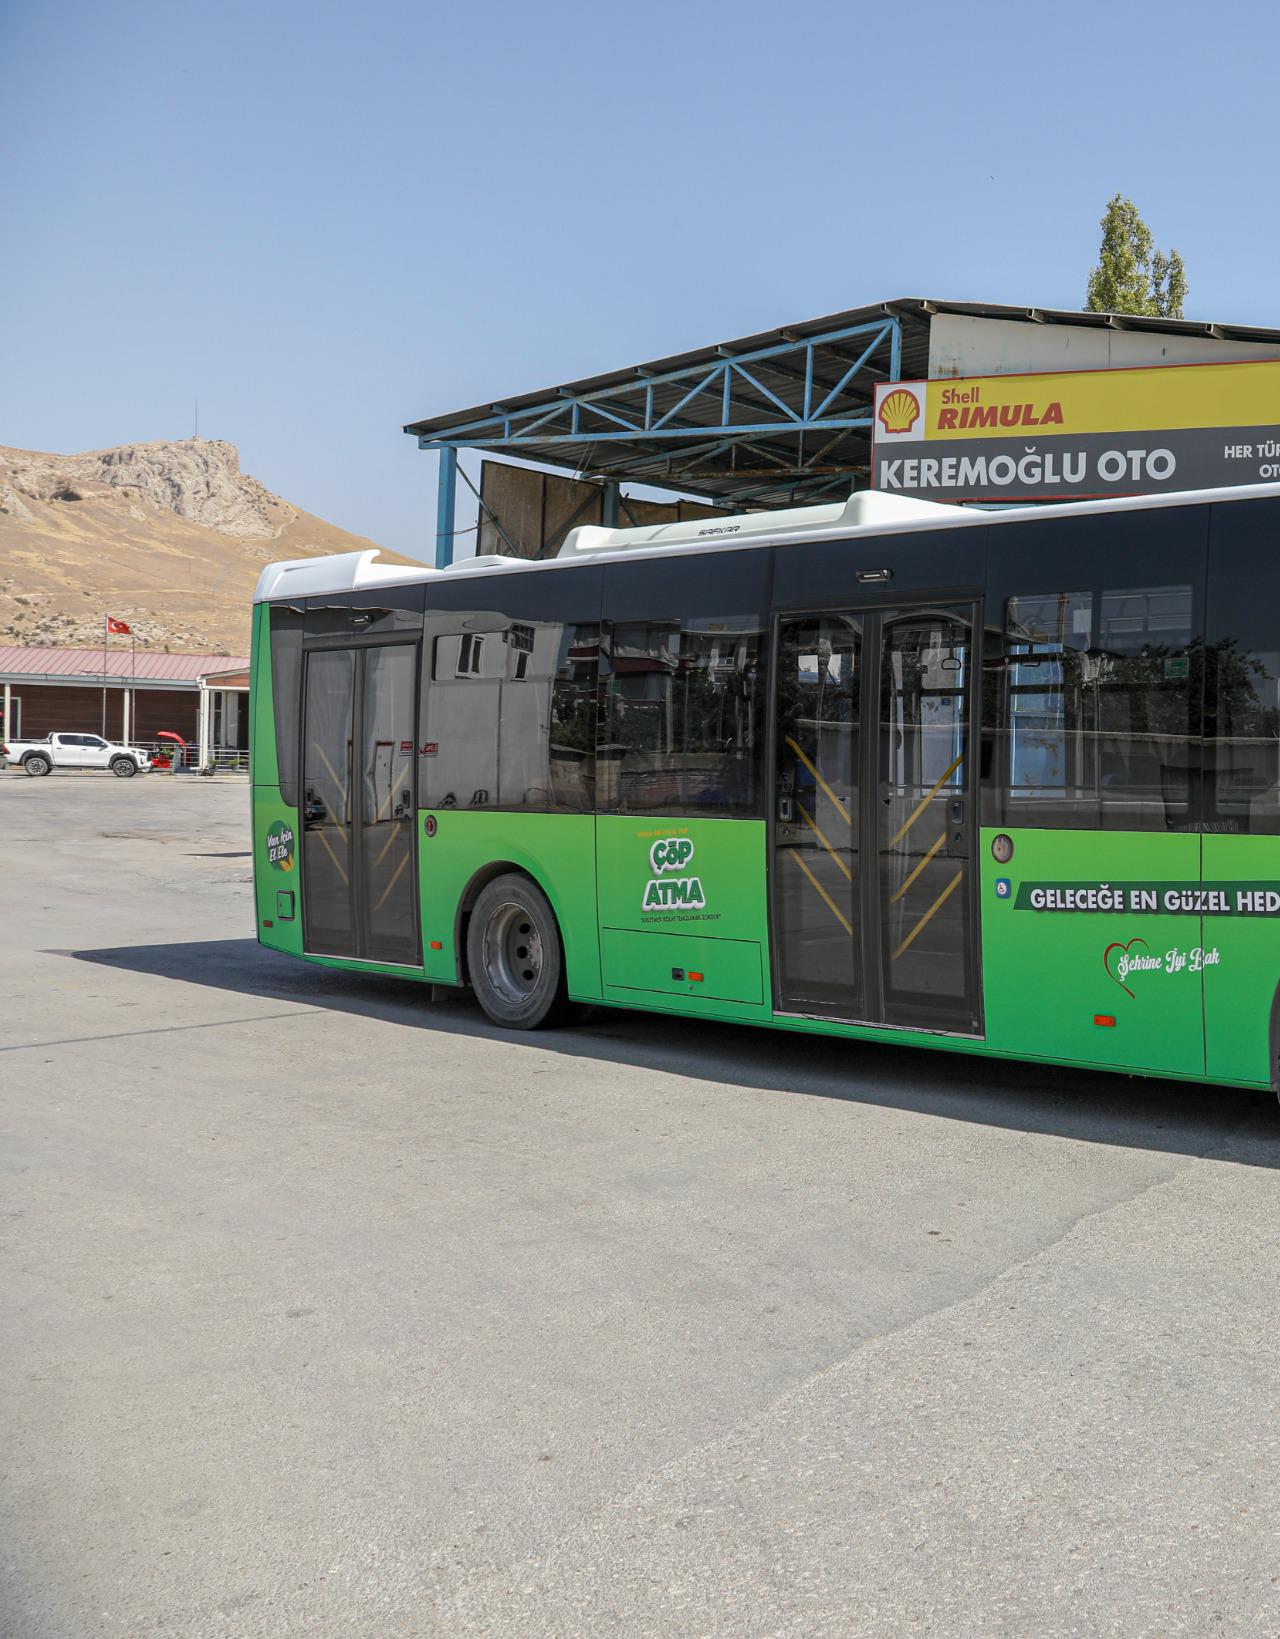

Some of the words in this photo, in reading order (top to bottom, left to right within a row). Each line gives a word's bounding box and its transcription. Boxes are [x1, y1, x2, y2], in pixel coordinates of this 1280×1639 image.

[941, 387, 980, 404] Shell
[937, 402, 1064, 430] RIMULA
[1224, 445, 1252, 459] HER
[879, 446, 1087, 489] KEREMOĞLU
[1097, 448, 1176, 482] OTO
[652, 839, 693, 872] ÇÖP
[643, 878, 705, 908] ATMA
[1030, 884, 1124, 909] GELECEĞE
[1130, 890, 1157, 910] EN
[1117, 953, 1162, 982] Şehrine
[1165, 947, 1186, 974] İyi
[1188, 947, 1220, 972] Bak
